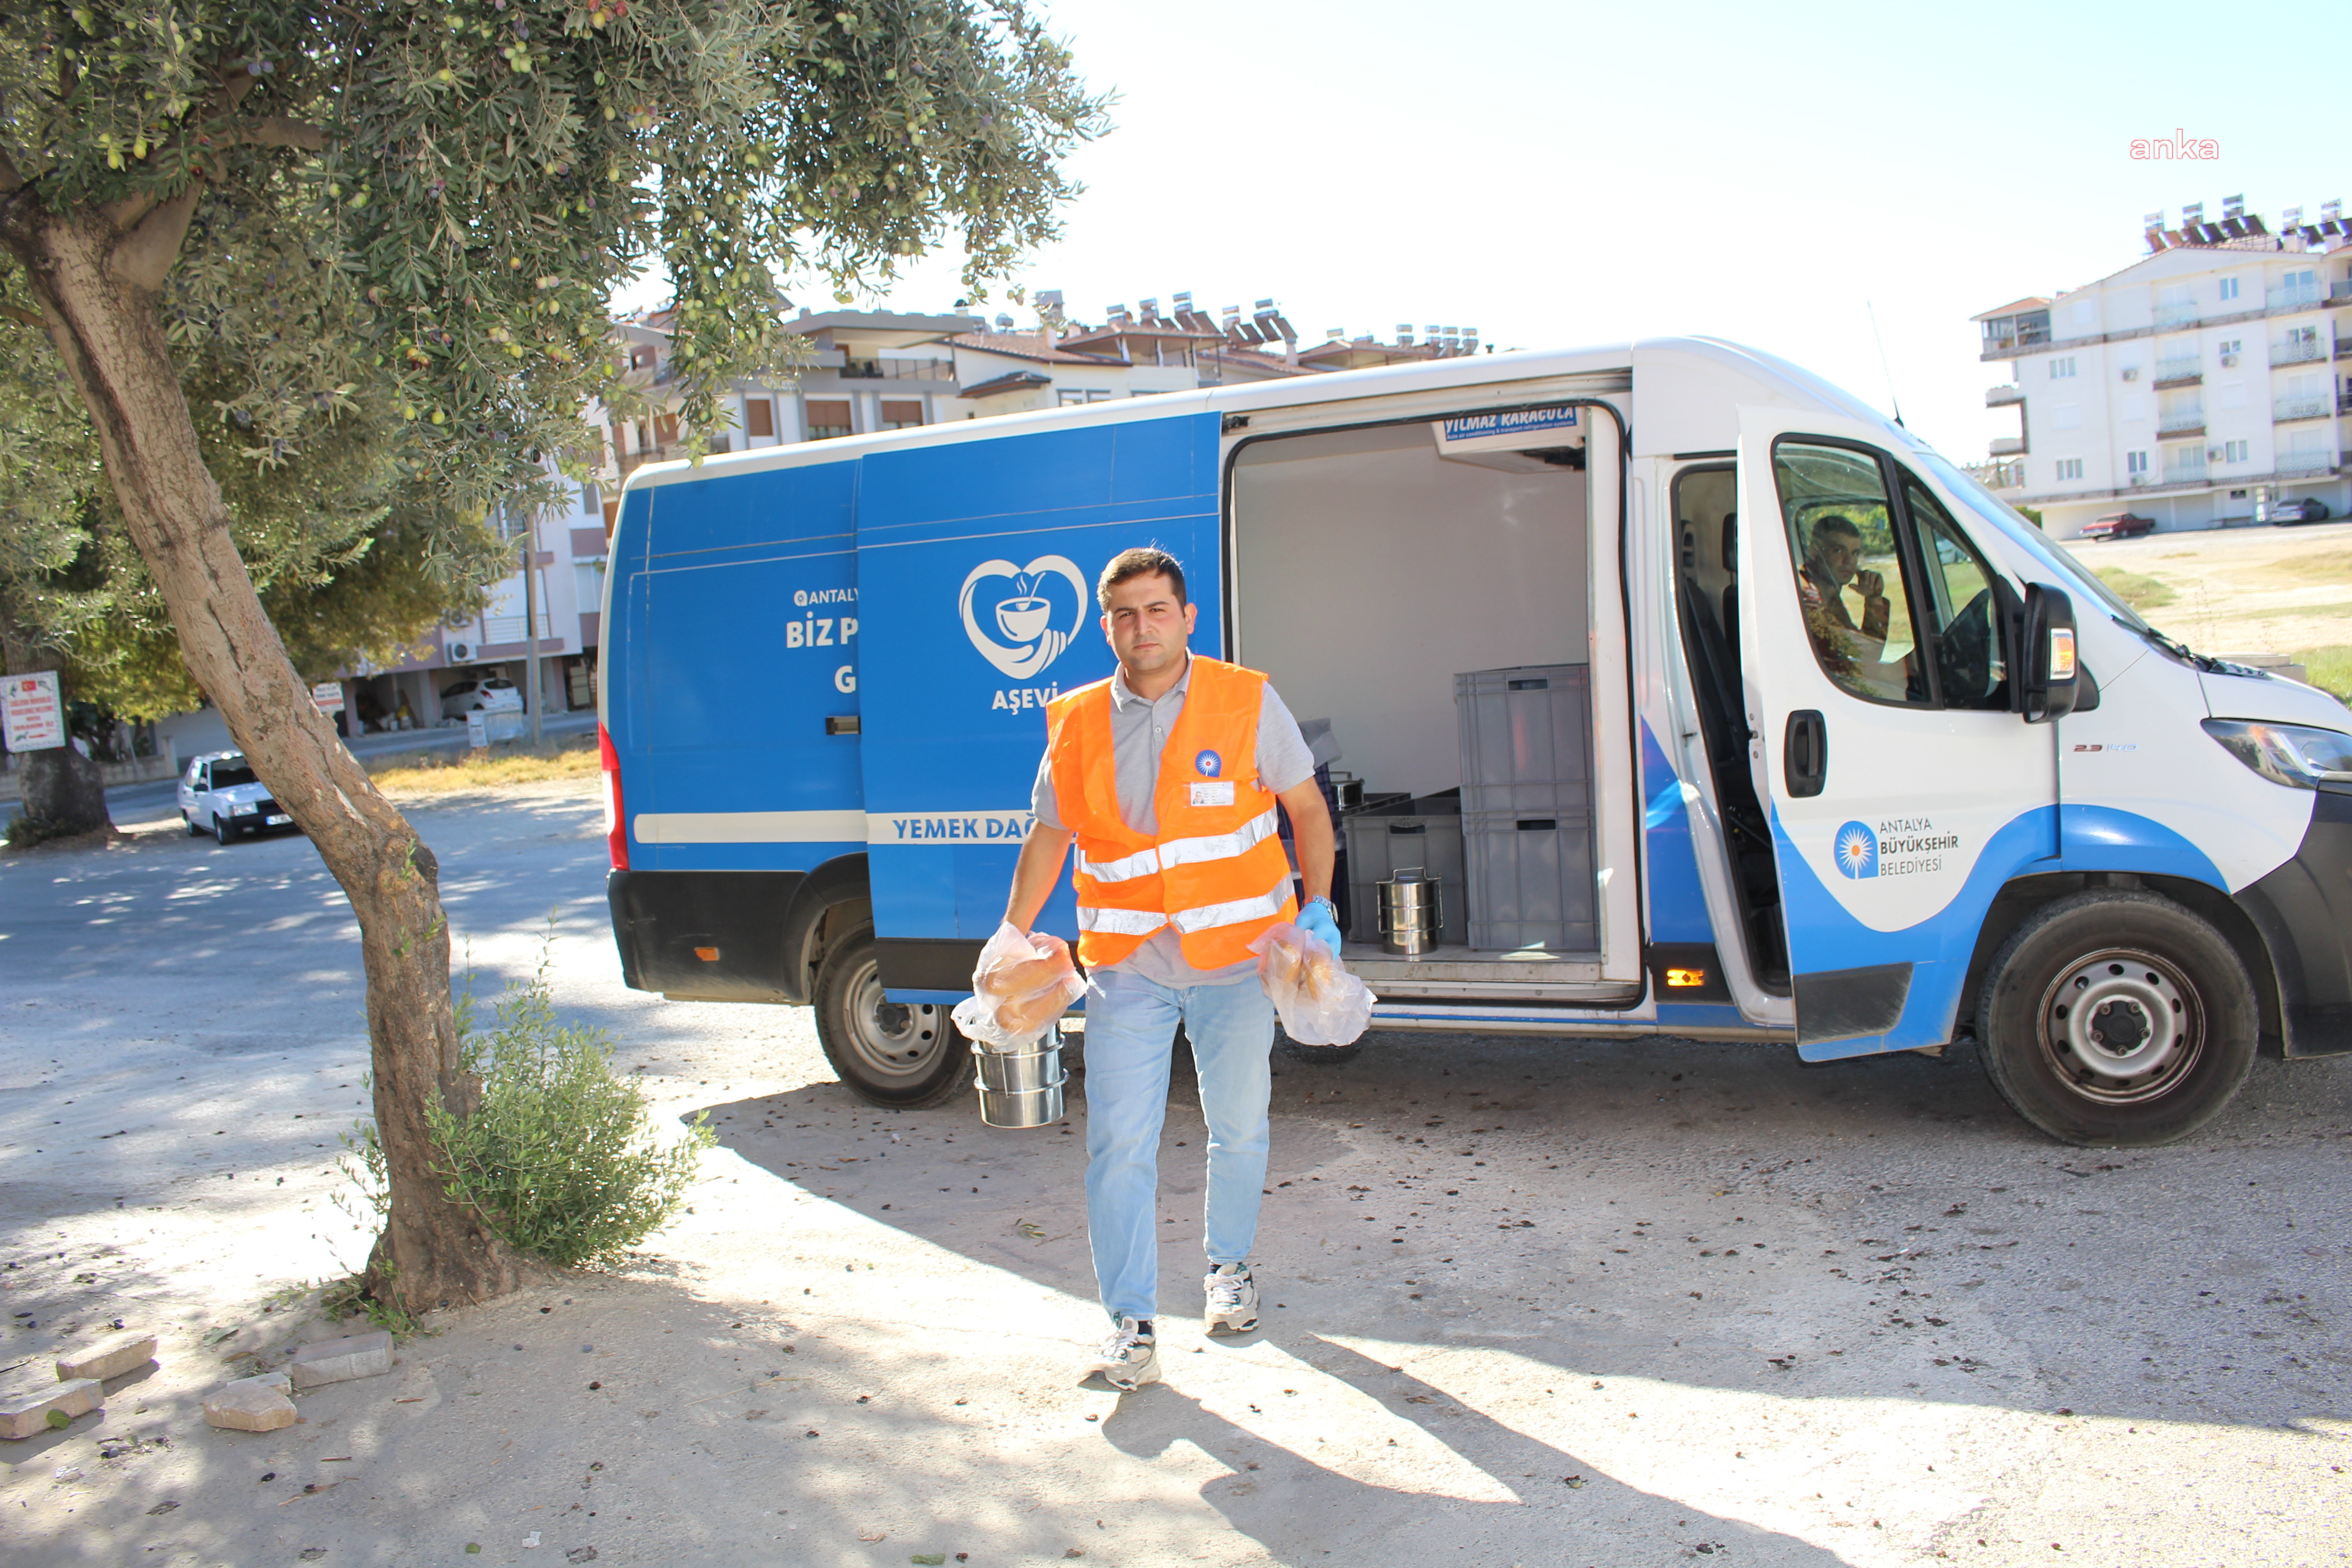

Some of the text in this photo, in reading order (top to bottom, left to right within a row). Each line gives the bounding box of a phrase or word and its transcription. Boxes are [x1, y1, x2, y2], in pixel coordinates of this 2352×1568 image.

[1445, 414, 1497, 433] YILMAZ
[1523, 422, 1553, 431] refrigeration
[786, 611, 833, 648] BİZ
[991, 681, 1058, 716] AŞEVİ
[2107, 744, 2138, 752] 140
[892, 818, 979, 839] YEMEK
[1879, 818, 1933, 834] ANTALYA
[1880, 830, 1959, 855] BÜYÜKŞEHİR
[1880, 854, 1942, 877] BELEDİYESİ
